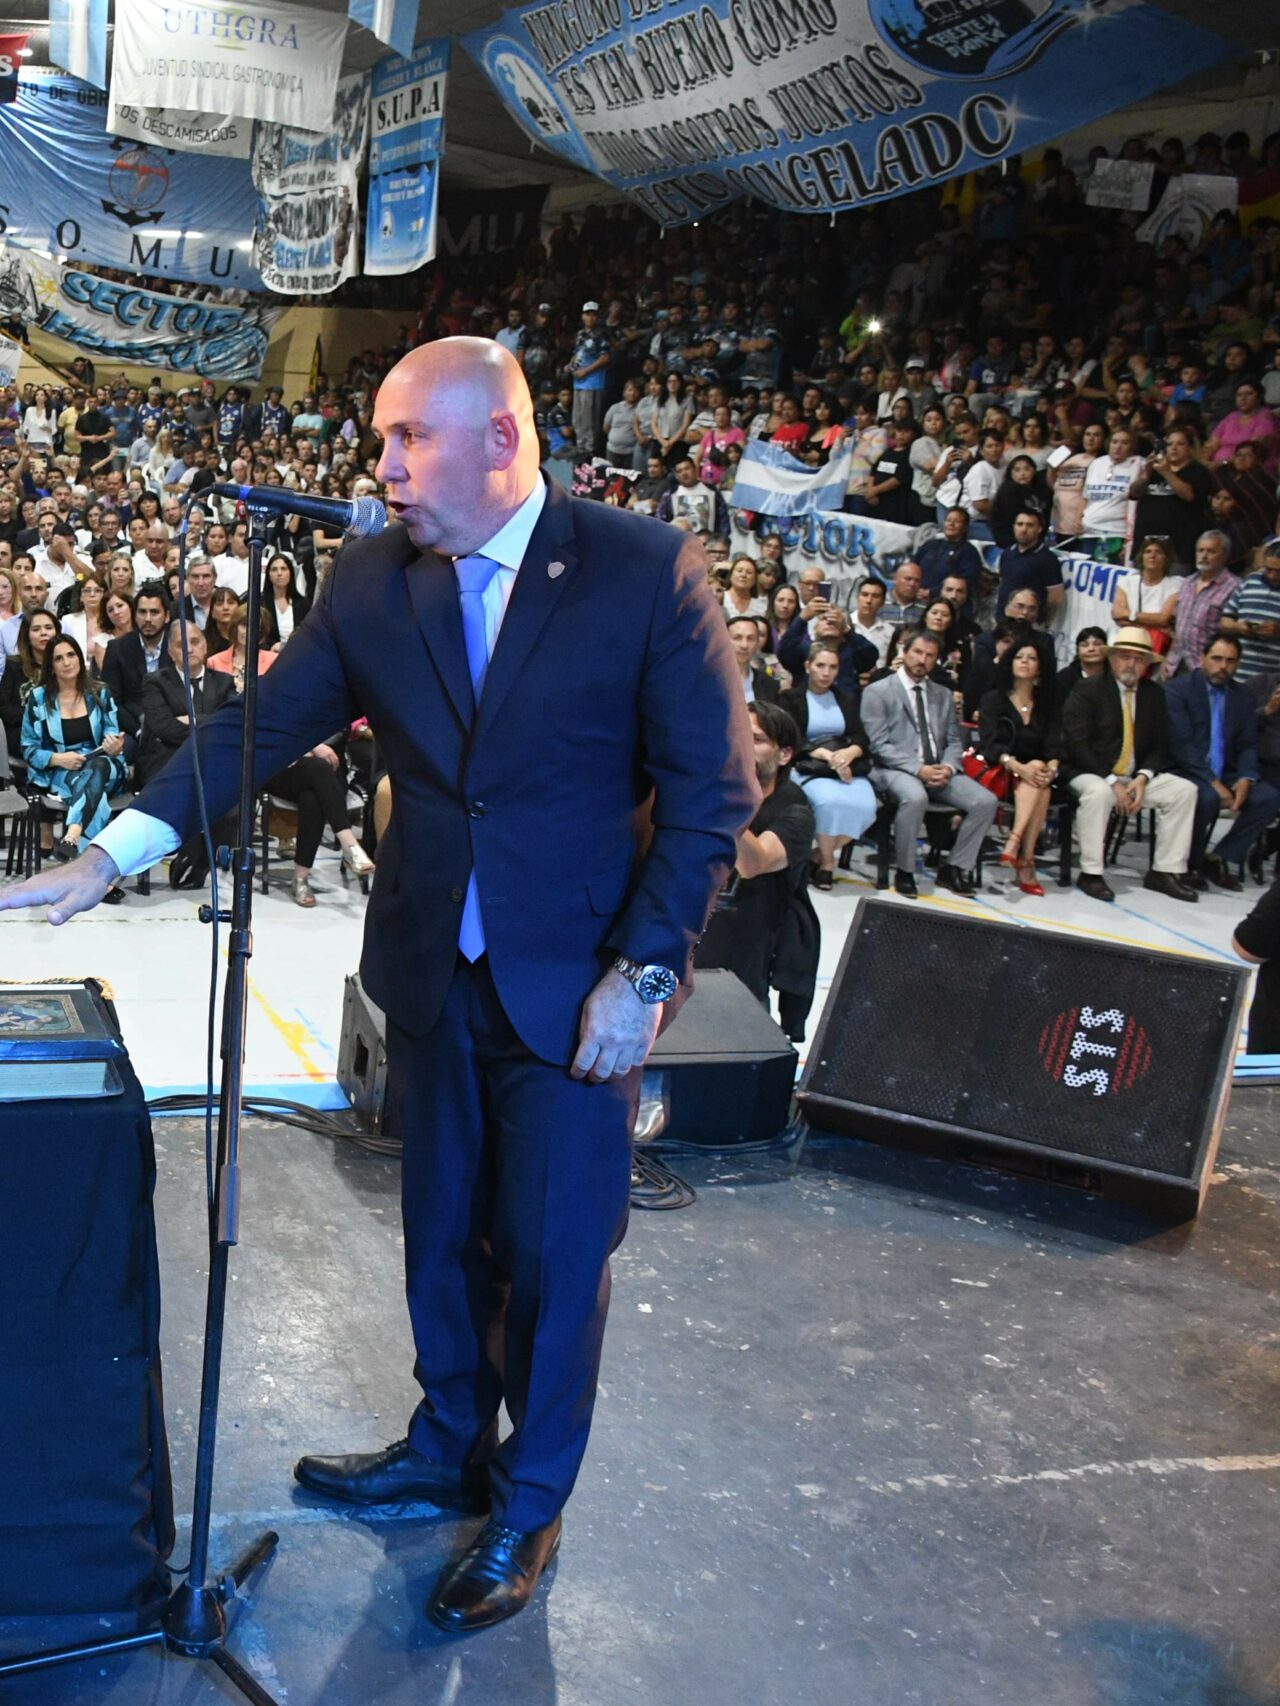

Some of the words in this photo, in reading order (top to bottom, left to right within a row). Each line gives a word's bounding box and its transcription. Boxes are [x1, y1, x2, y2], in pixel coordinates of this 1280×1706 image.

[163, 8, 300, 50] UTHGRA
[633, 5, 734, 100] BUENO
[141, 57, 187, 77] JUVENTUD
[190, 60, 230, 81] SINDICAL
[113, 105, 140, 124] OS
[141, 116, 239, 143] DESCAMISADOS
[61, 269, 246, 337] SECTOR
[1063, 1006, 1125, 1096] STS
